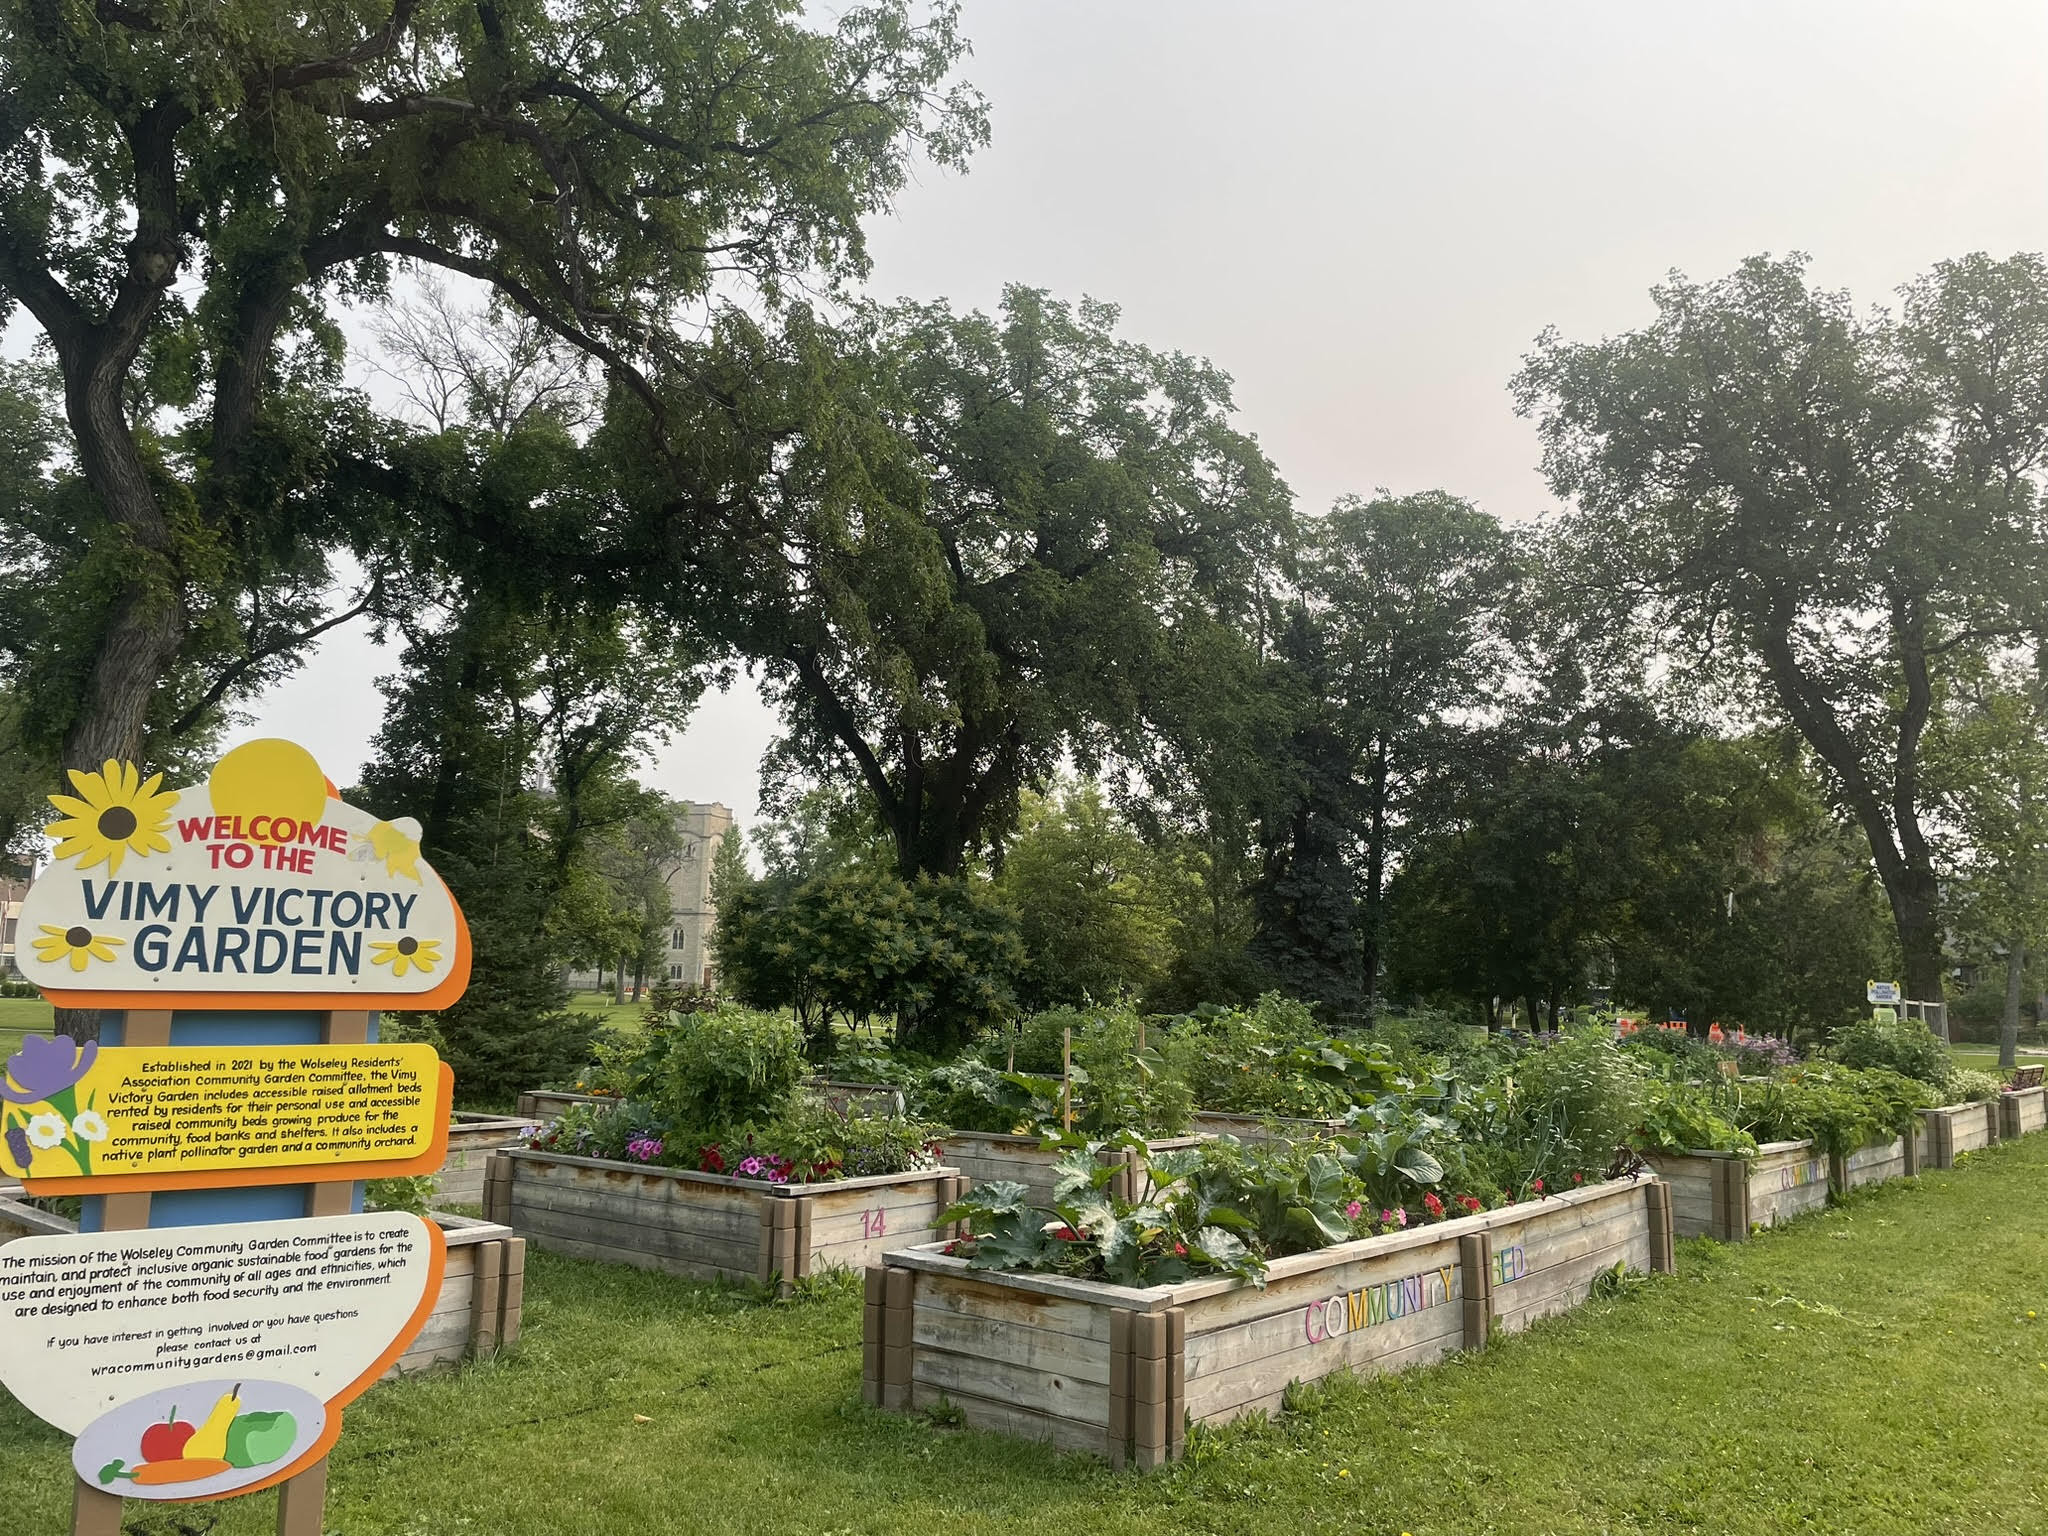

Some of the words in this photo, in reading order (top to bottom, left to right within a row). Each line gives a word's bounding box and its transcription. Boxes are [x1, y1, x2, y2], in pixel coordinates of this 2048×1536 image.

[178, 815, 348, 856] WELCOME
[206, 844, 254, 870] TO
[261, 844, 316, 875] THE
[81, 879, 219, 924] VIMY
[231, 886, 418, 930] VICTORY
[133, 924, 363, 976] GARDEN
[121, 1075, 190, 1087] Association
[196, 1073, 260, 1086] Community
[264, 1073, 305, 1084] Garden
[371, 1070, 388, 1081] the
[391, 1069, 417, 1081] Vimy
[142, 1060, 211, 1073] Established
[216, 1060, 226, 1070] in
[231, 1060, 253, 1070] 2021
[260, 1059, 274, 1072] by
[278, 1059, 296, 1070] the
[300, 1058, 348, 1070] Wolseley
[107, 1105, 149, 1118] rented
[154, 1105, 168, 1117] by
[171, 1103, 222, 1116] residents
[226, 1102, 243, 1113] for
[248, 1100, 273, 1113] their
[276, 1099, 321, 1113] personal
[325, 1100, 344, 1109] use
[349, 1098, 367, 1108] and
[370, 1096, 421, 1107] accessible
[109, 1091, 153, 1104] Victory
[158, 1090, 199, 1102] Garden
[204, 1089, 249, 1101] includes
[253, 1086, 307, 1098] accessible
[312, 1085, 344, 1096] raised
[348, 1083, 393, 1094] allotment
[397, 1082, 422, 1093] beds
[132, 1119, 171, 1131] raised
[176, 1117, 237, 1130] community
[242, 1115, 268, 1127] beds
[272, 1115, 312, 1128] growing
[317, 1113, 360, 1126] produce
[365, 1111, 379, 1121] for
[383, 1110, 399, 1120] the
[186, 1132, 211, 1143] food
[215, 1130, 250, 1142] banks
[255, 1127, 277, 1140] and
[281, 1127, 328, 1138] shelters.
[332, 1127, 340, 1136] It
[342, 1125, 363, 1136] also
[366, 1124, 406, 1135] includes
[102, 1149, 143, 1162] native
[148, 1147, 177, 1163] plant
[181, 1145, 236, 1160] pollinator
[239, 1141, 278, 1158] garden
[282, 1141, 302, 1152] and
[305, 1142, 312, 1151] a
[316, 1138, 371, 1151] community
[374, 1135, 417, 1147] orchard.
[860, 1206, 887, 1239] 14
[2, 1256, 25, 1269] The
[29, 1254, 76, 1267] mission
[79, 1252, 95, 1264] of
[97, 1250, 118, 1262] the
[121, 1247, 174, 1261] Wolseley
[176, 1241, 243, 1257] Community
[248, 1237, 290, 1251] Garden
[293, 1232, 352, 1247] Committee
[354, 1231, 363, 1241] is
[365, 1230, 375, 1241] to
[379, 1228, 410, 1240] create
[61, 1269, 87, 1281] and
[89, 1265, 132, 1284] protect
[137, 1263, 188, 1276] inclusive
[191, 1258, 234, 1273] organic
[237, 1252, 301, 1267] sustainable
[304, 1248, 329, 1261] food
[333, 1246, 376, 1262] gardens
[379, 1243, 394, 1255] for
[397, 1242, 413, 1253] the
[2, 1290, 25, 1301] use
[29, 1286, 55, 1299] and
[58, 1282, 123, 1300] enjoyment
[127, 1280, 140, 1291] of
[143, 1278, 163, 1290] the
[166, 1273, 231, 1289] community
[234, 1271, 246, 1283] of
[248, 1269, 261, 1281] all
[265, 1269, 291, 1282] ages
[295, 1265, 317, 1277] and
[320, 1259, 375, 1274] ethnicities,
[377, 1257, 407, 1269] which
[1492, 1245, 1525, 1287] BED
[15, 1306, 38, 1317] are
[41, 1300, 98, 1317] designed
[101, 1299, 114, 1310] to
[117, 1295, 168, 1309] enhance
[171, 1291, 199, 1304] both
[203, 1287, 230, 1301] food
[233, 1282, 279, 1298] security
[282, 1281, 304, 1294] and
[307, 1280, 323, 1291] the
[47, 1337, 56, 1348] If
[58, 1339, 79, 1350] you
[83, 1335, 109, 1345] have
[112, 1330, 152, 1342] interest
[155, 1328, 164, 1338] in
[167, 1326, 203, 1339] getting
[208, 1319, 249, 1333] involved
[252, 1319, 265, 1329] or
[267, 1318, 285, 1329] you
[287, 1315, 310, 1325] have
[313, 1309, 359, 1324] questions
[156, 1342, 189, 1357] please
[194, 1337, 232, 1350] contact
[235, 1336, 248, 1345] us
[250, 1334, 262, 1344] at
[91, 1343, 317, 1377] wracommunitygardens@gmail.com
